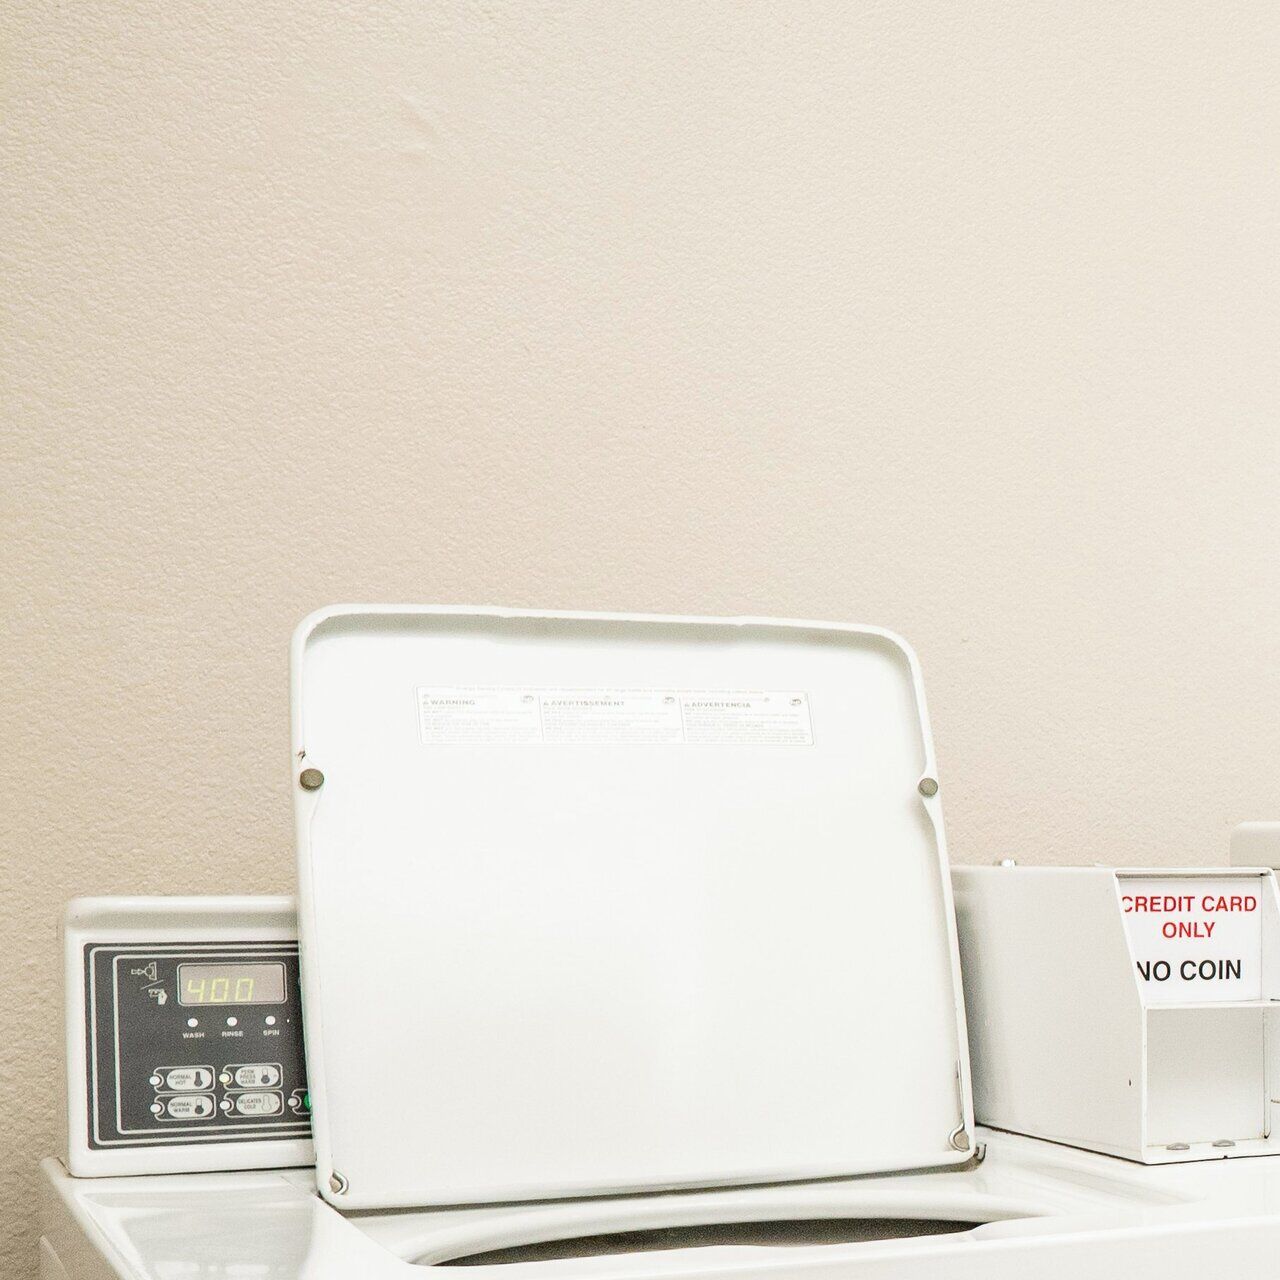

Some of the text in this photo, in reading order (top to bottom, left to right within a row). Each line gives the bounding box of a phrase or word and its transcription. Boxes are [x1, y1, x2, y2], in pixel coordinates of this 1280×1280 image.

[1122, 896, 1256, 912] CREDIT CARD
[1162, 922, 1215, 938] ONLY
[1137, 960, 1241, 981] NO COIN
